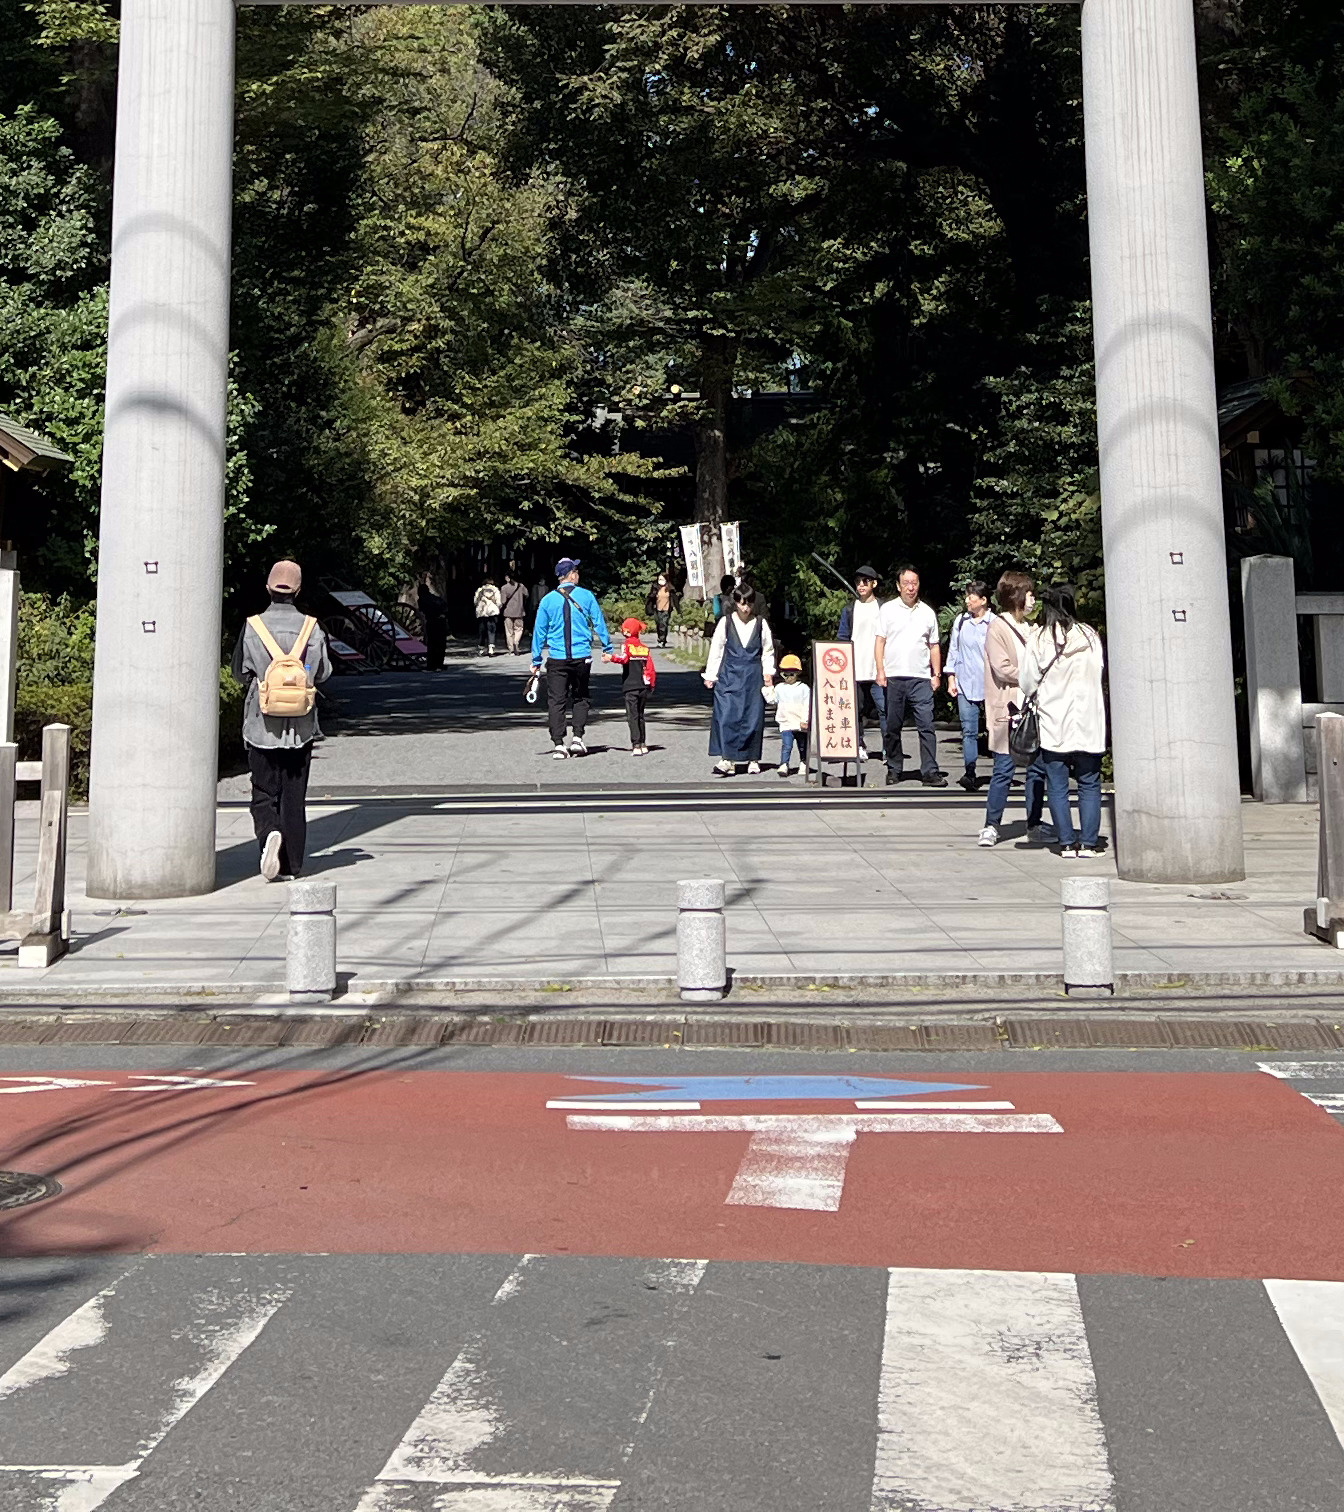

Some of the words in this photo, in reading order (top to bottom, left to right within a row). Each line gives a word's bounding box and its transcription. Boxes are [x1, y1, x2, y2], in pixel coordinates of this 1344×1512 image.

[823, 677, 838, 749] 入れません
[838, 677, 853, 749] 自転車は
